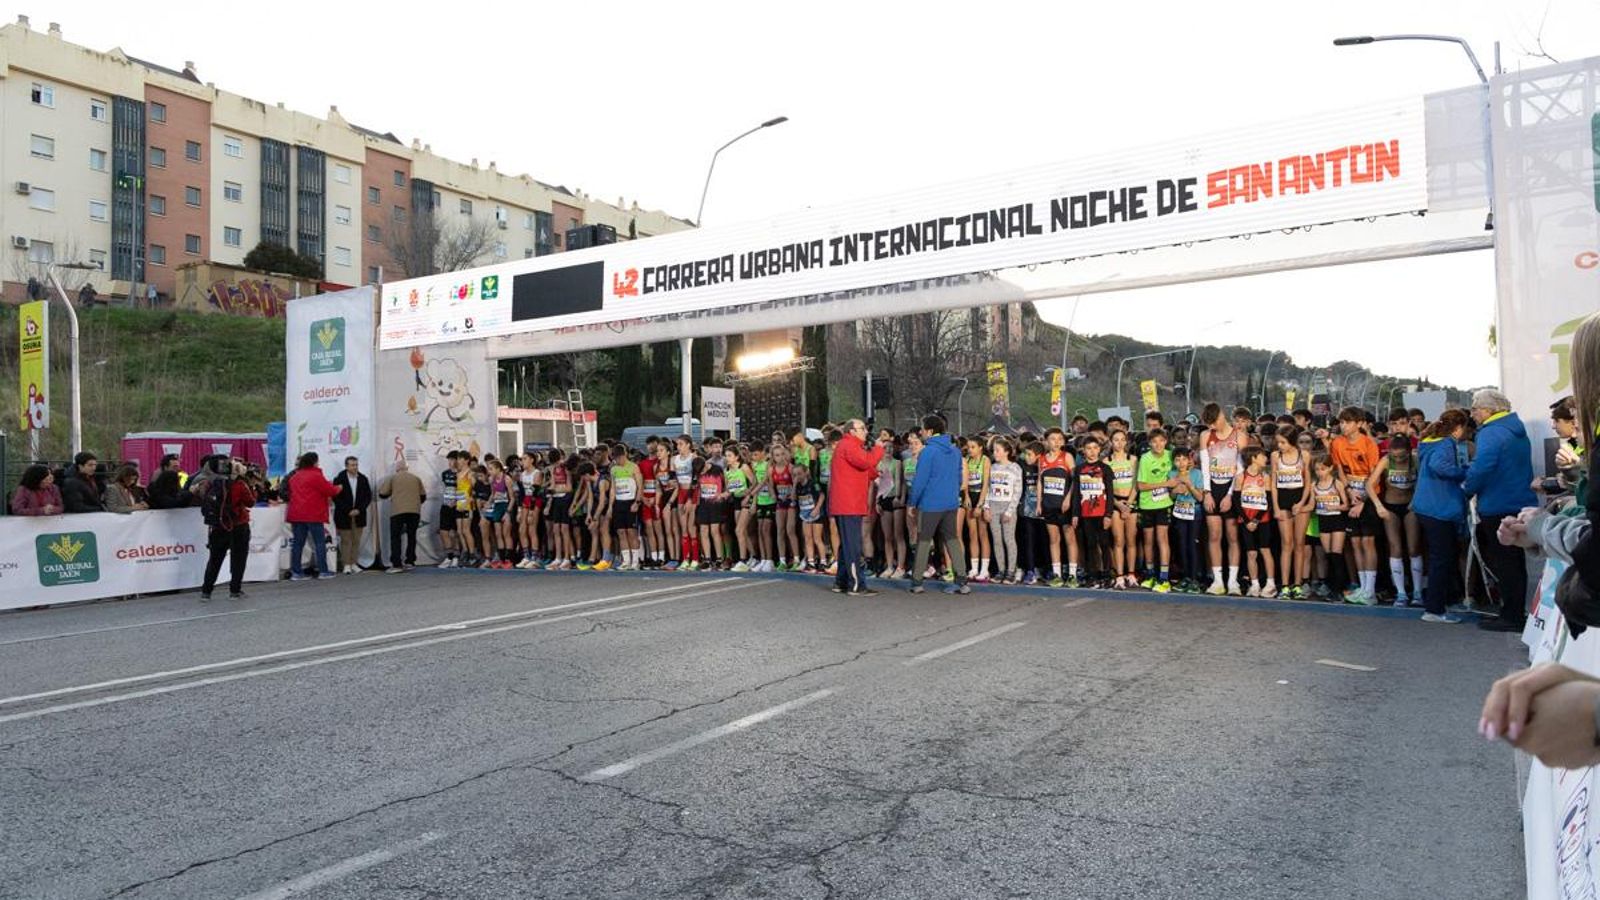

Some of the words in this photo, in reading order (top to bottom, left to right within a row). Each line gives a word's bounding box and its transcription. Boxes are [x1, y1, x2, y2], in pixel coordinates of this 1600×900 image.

[613, 268, 639, 298] 42
[643, 254, 734, 295] CARRERA
[739, 240, 823, 280] URBANA
[829, 203, 1043, 268] INTERNACIONAL
[1050, 186, 1148, 233] NOCHE
[1156, 177, 1198, 217] DE
[1207, 161, 1273, 209] SAN
[303, 384, 350, 400] calderón
[116, 542, 195, 559] calderón
[43, 564, 65, 573] CAJA
[66, 562, 95, 571] RURAL
